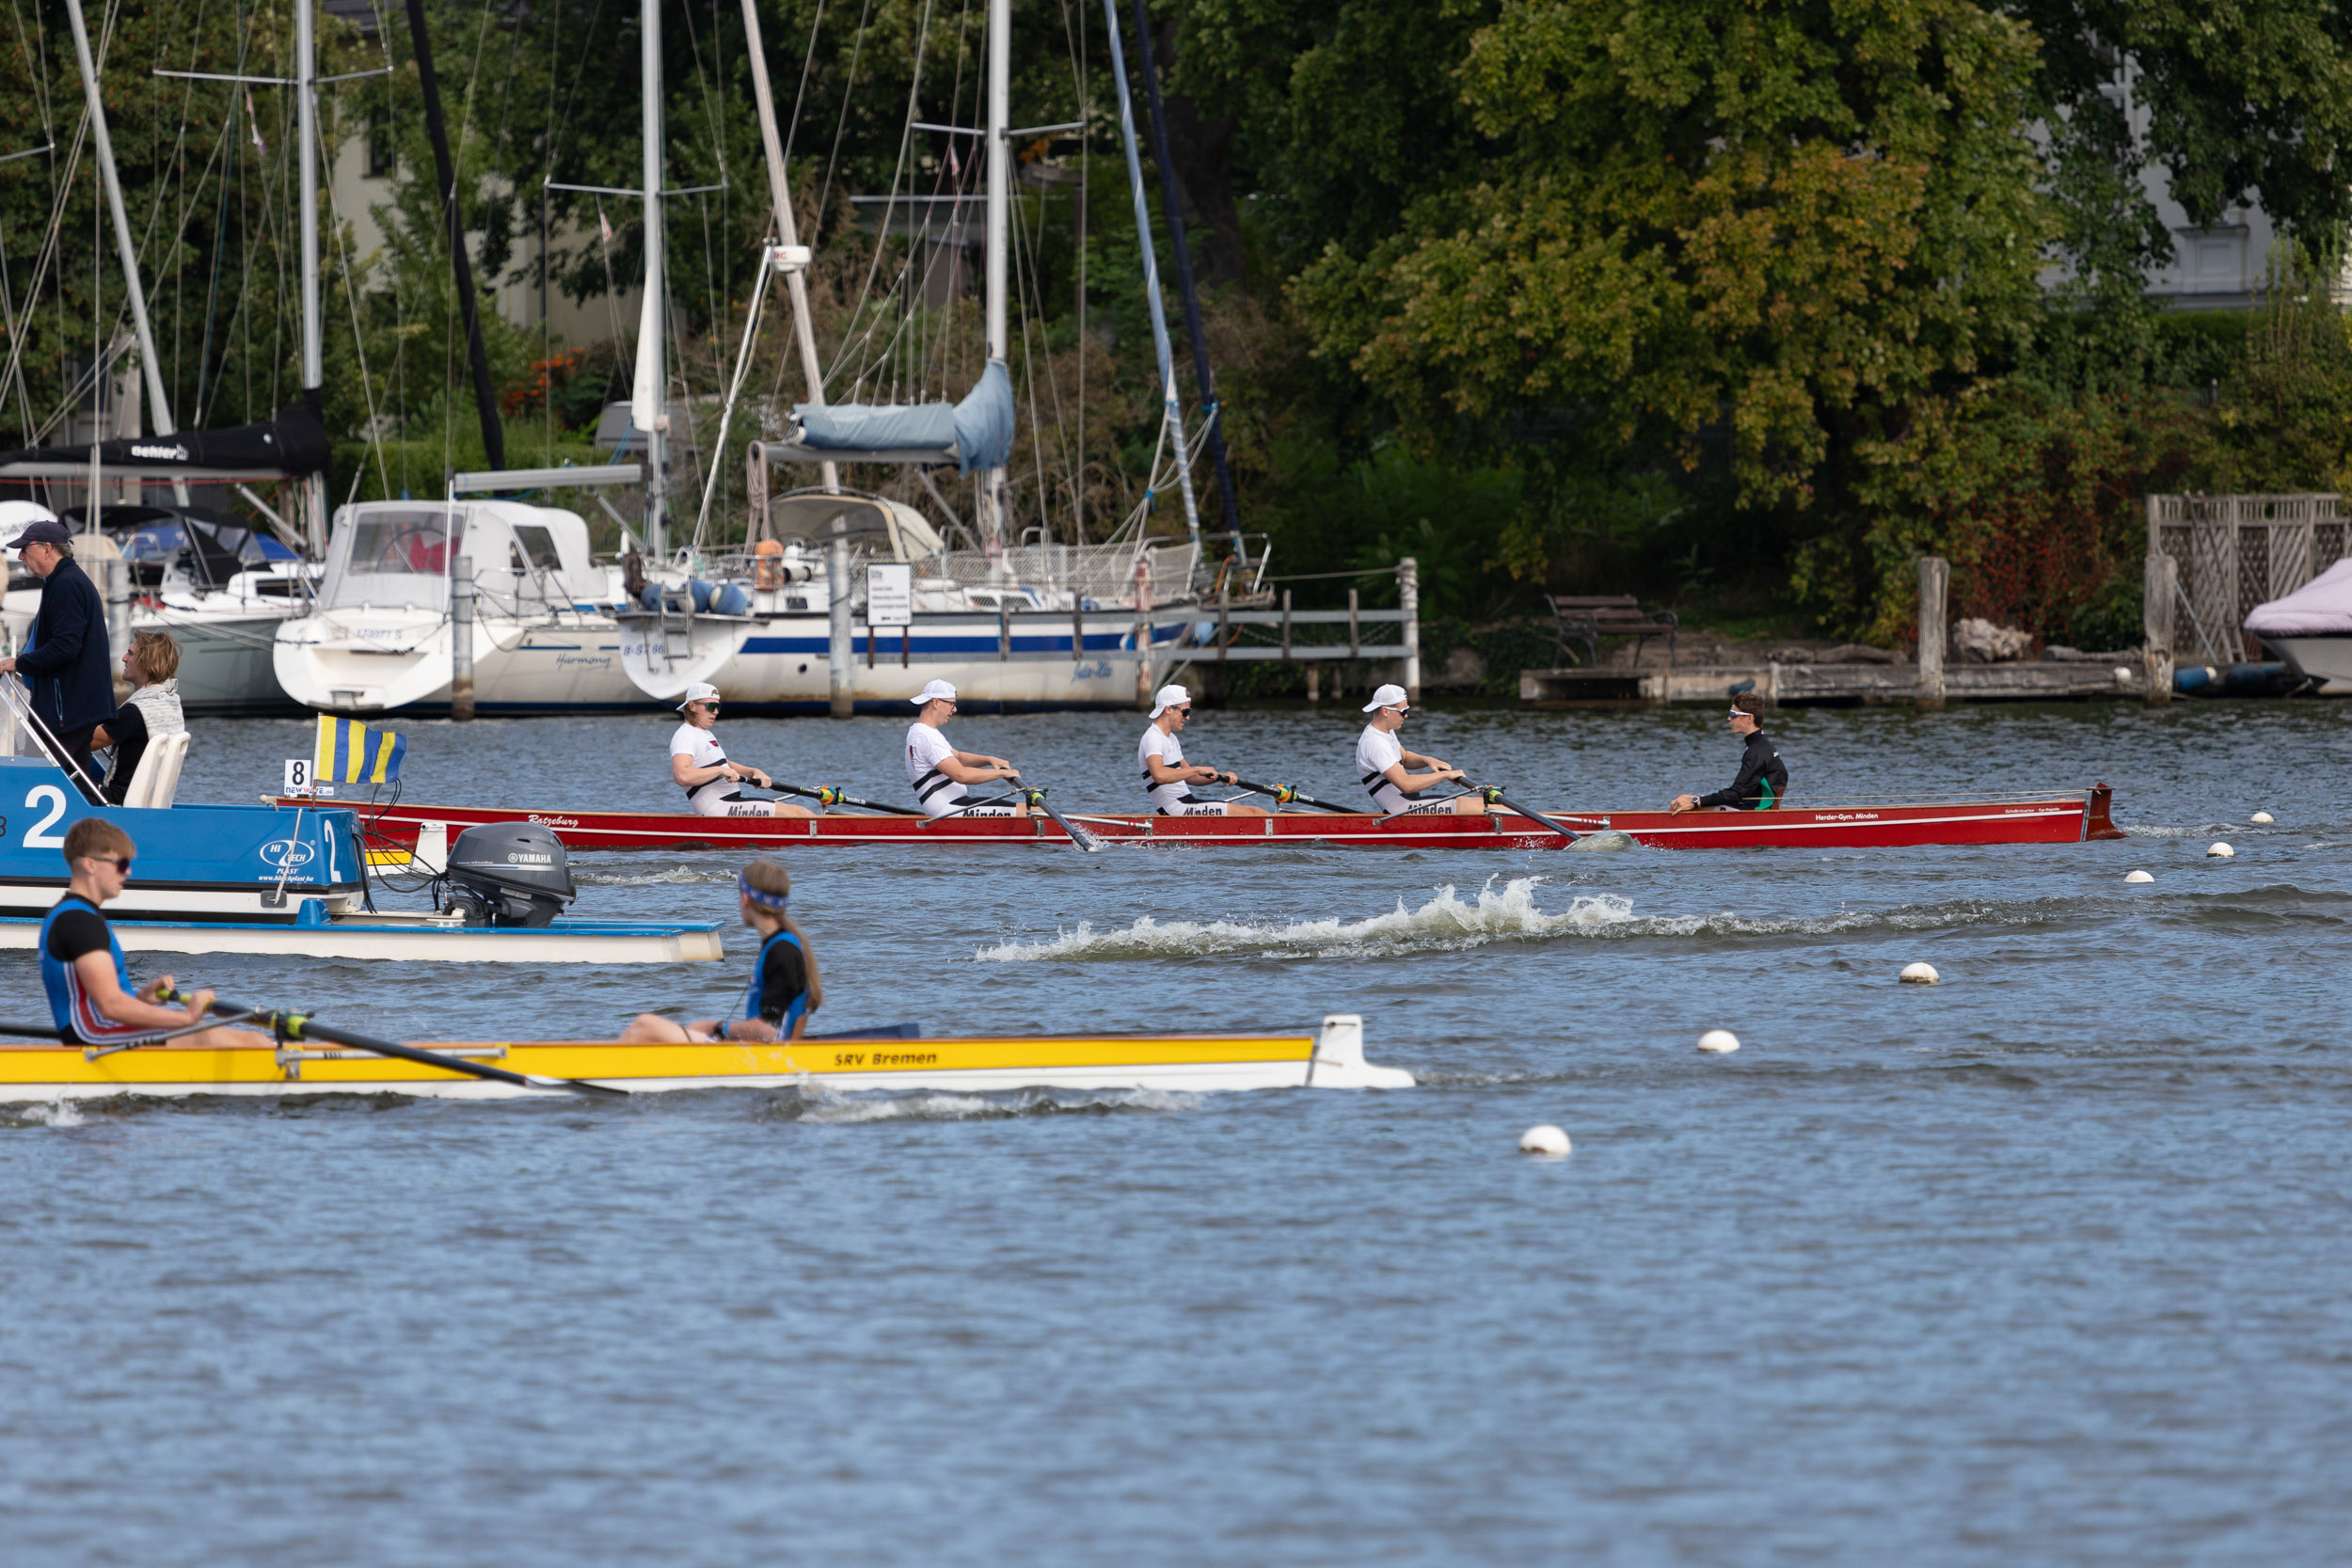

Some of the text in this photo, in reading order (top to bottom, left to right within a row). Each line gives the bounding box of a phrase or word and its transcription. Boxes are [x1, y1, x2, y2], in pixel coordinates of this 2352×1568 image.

[556, 652, 611, 670] Harmony
[293, 761, 305, 785] 8
[23, 784, 67, 848] 2
[528, 814, 580, 828] Ratzeburg
[1855, 812, 1879, 820] Minden
[269, 844, 281, 853] HI
[324, 819, 342, 883] 2
[287, 853, 306, 863] TECH
[518, 853, 552, 863] YAMAHA
[834, 1053, 938, 1066] SRV Bremen
